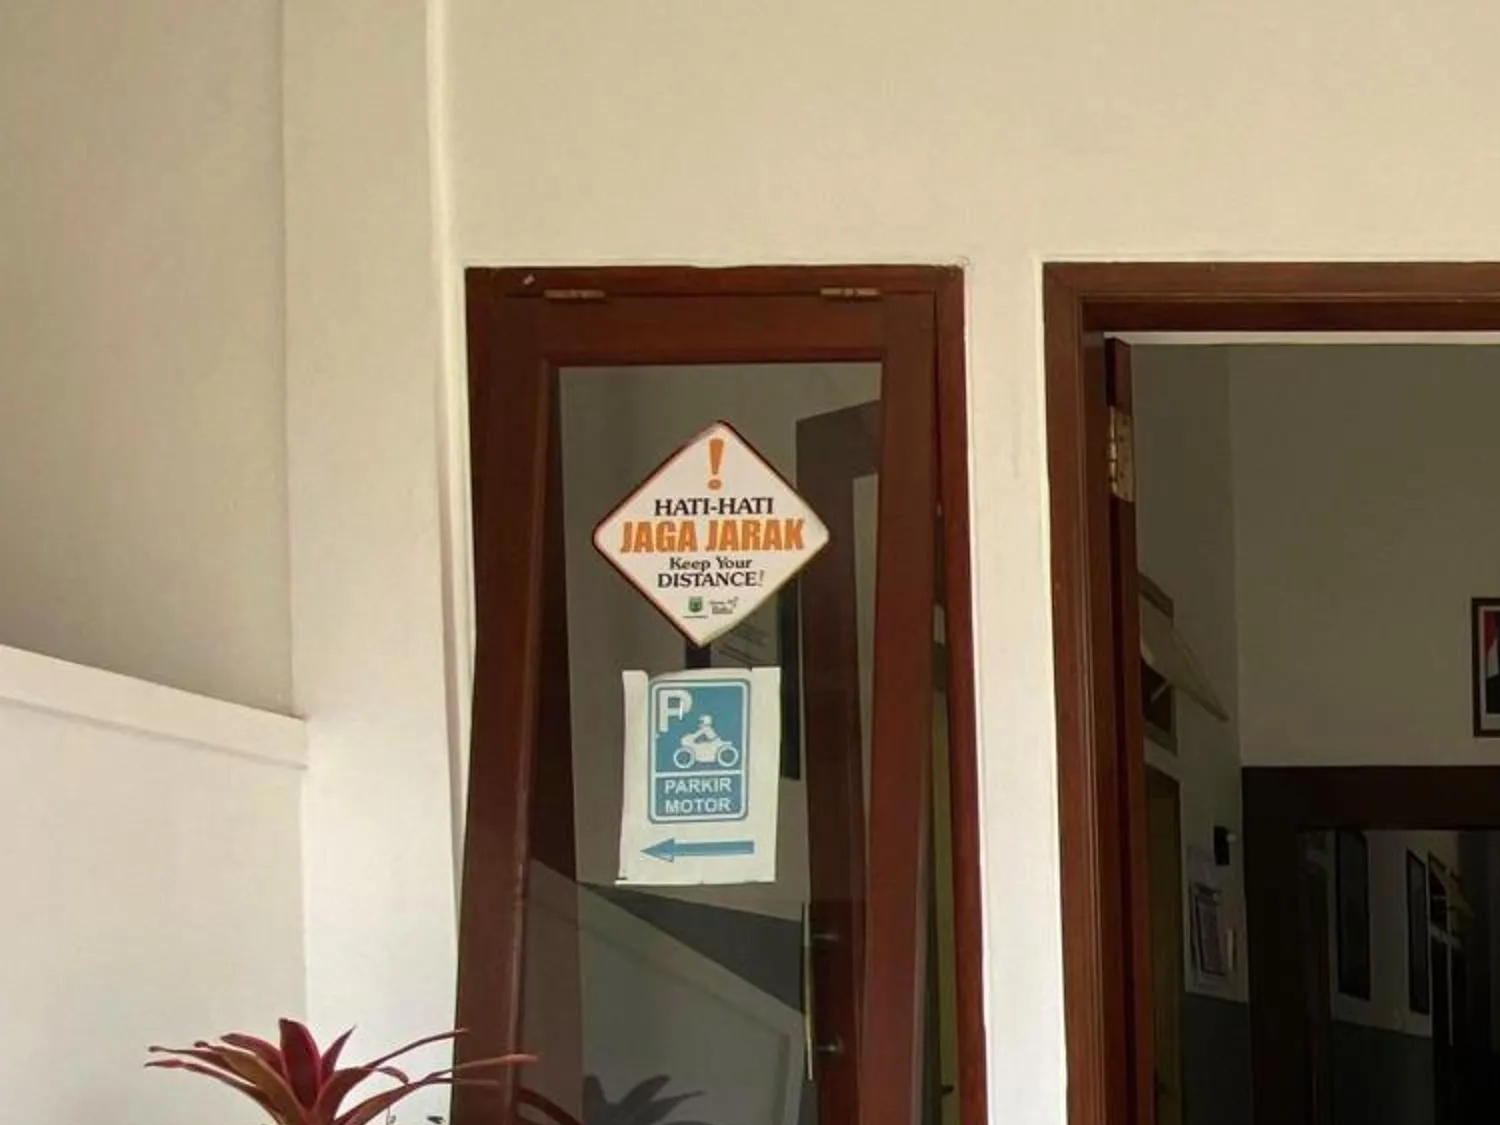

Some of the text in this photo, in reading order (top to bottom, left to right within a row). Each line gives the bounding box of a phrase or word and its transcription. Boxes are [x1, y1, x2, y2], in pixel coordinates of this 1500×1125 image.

[653, 497, 774, 517] HATI-HATI
[620, 518, 805, 554] JAGA JARAK
[669, 556, 753, 572] Keep Your
[657, 570, 765, 589] DISTANCE!
[658, 689, 693, 733] P
[664, 777, 733, 794] PARKIR
[664, 798, 732, 815] MOTOR
